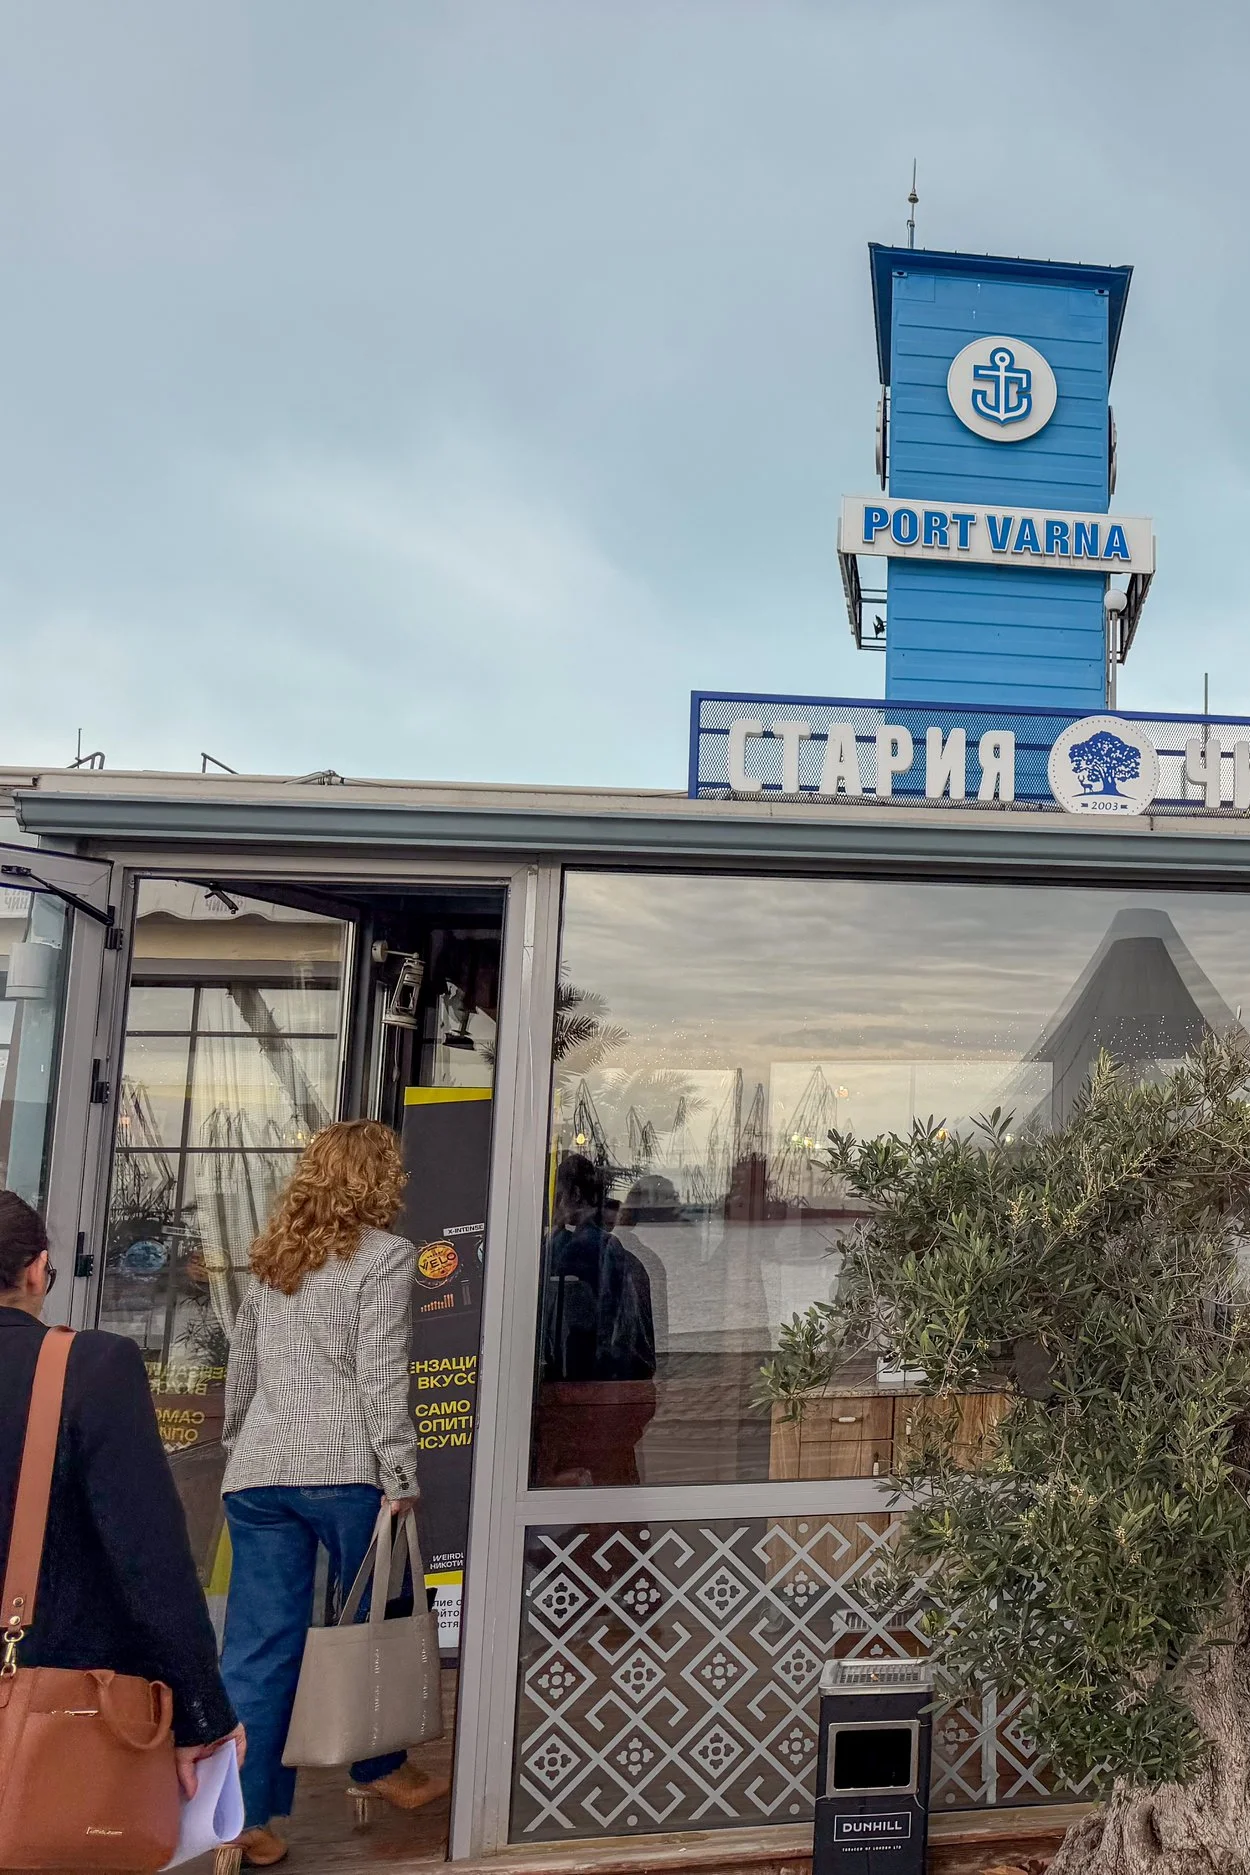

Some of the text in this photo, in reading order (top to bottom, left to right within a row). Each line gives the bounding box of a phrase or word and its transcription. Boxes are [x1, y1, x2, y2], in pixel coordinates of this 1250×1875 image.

[862, 505, 1131, 561] PORT VARNA
[728, 719, 1015, 802] СТАРИЯ
[1091, 801, 1119, 811] 2003
[420, 1251, 457, 1271] VELO
[415, 1400, 471, 1417] САМО
[842, 1820, 903, 1834] DUNHILL
